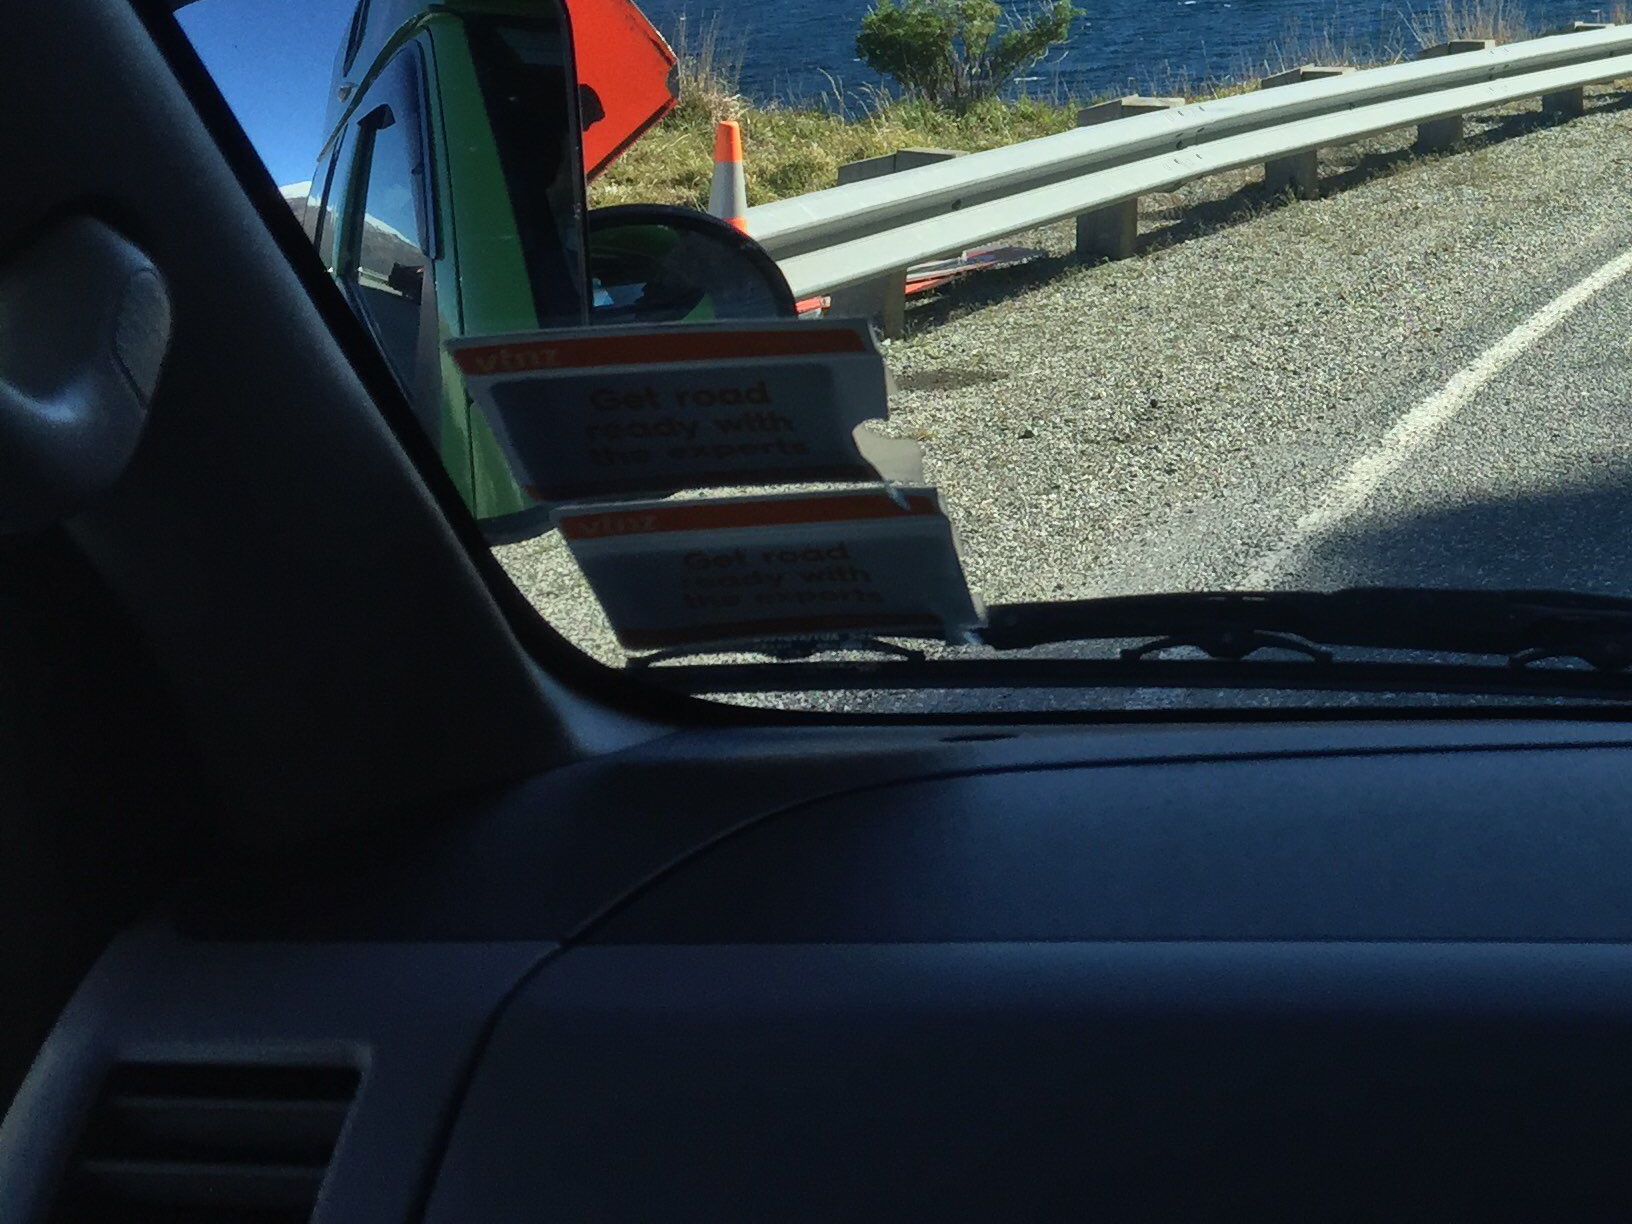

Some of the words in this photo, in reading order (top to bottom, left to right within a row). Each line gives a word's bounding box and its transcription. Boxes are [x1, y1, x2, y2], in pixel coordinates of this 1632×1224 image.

[590, 385, 660, 410] Get
[677, 379, 772, 407] road
[713, 413, 795, 435] with
[684, 548, 747, 569] Get
[761, 541, 851, 563] road
